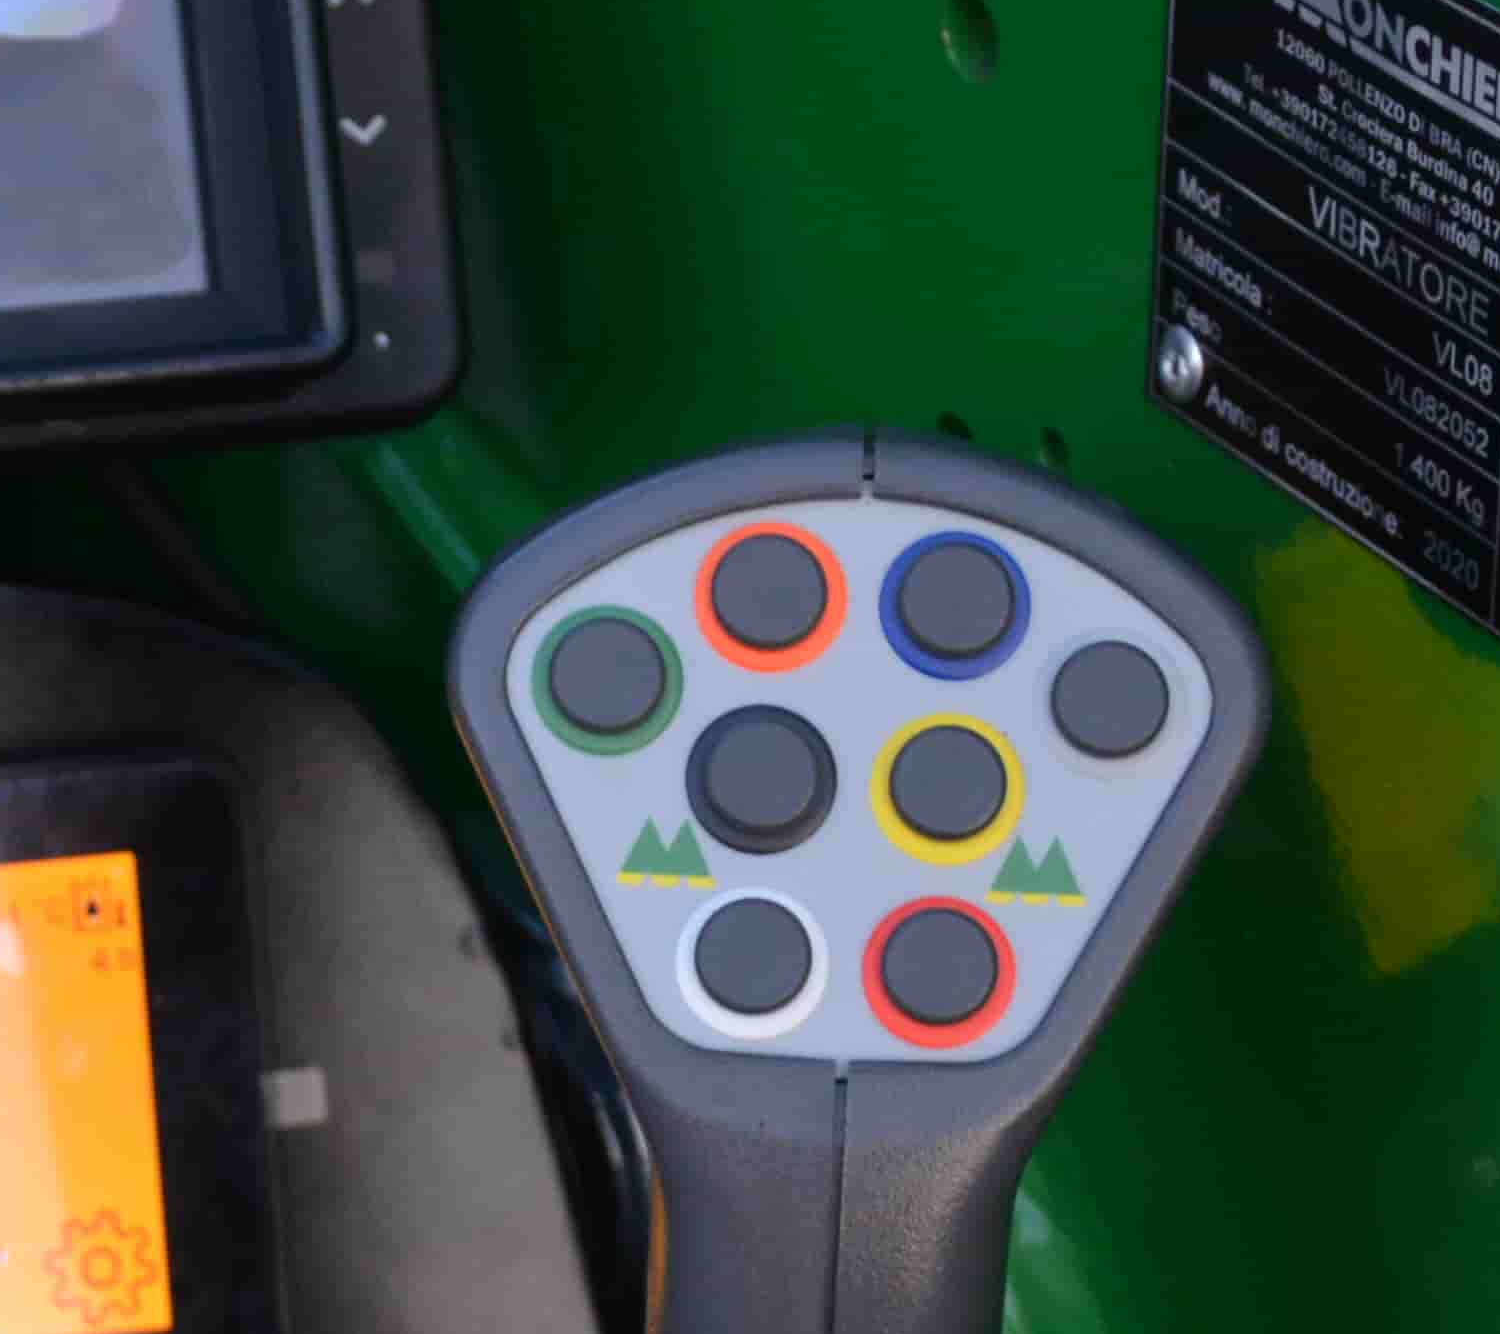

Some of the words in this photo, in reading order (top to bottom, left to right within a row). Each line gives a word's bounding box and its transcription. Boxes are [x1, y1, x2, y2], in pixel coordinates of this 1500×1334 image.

[1278, 30, 1324, 71] 12060
[1467, 145, 1499, 182] (CN)
[1407, 141, 1467, 190] Burdina
[1472, 179, 1494, 205] 40
[1410, 170, 1436, 200] Fax
[1307, 186, 1489, 335] VIBRATORE
[1431, 331, 1493, 395] VL08
[1261, 418, 1279, 453] di
[1423, 527, 1479, 591] 2020
[1456, 478, 1485, 525] Kg
